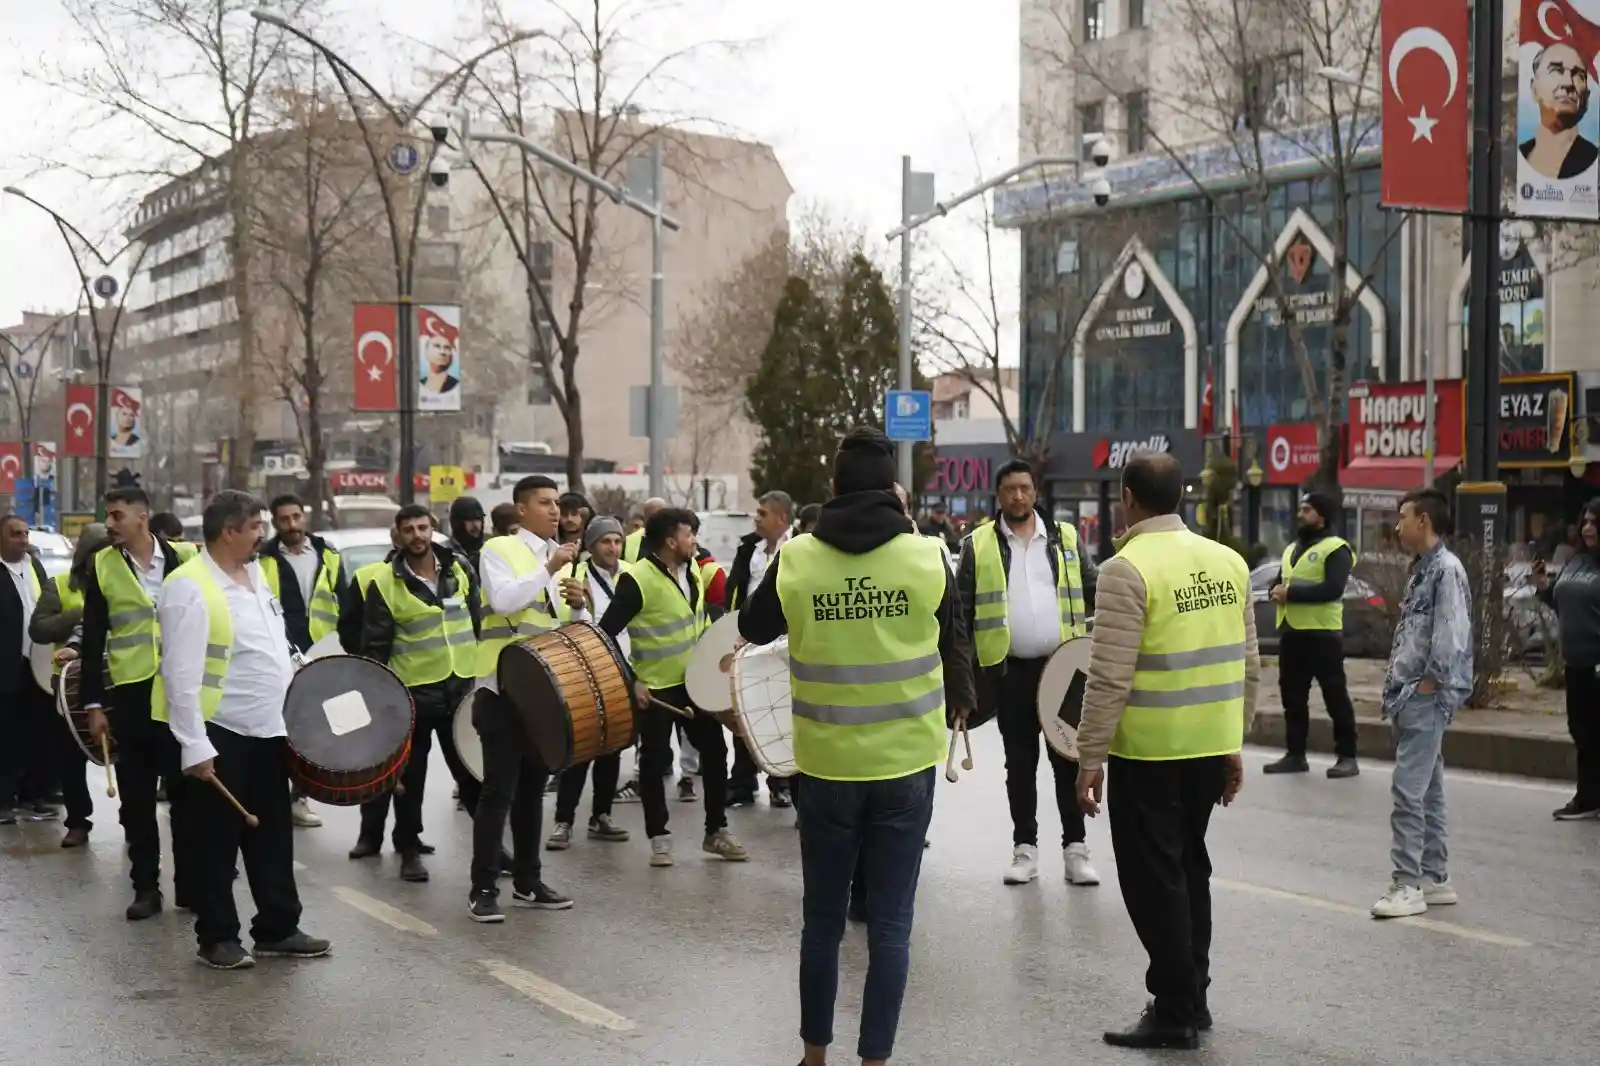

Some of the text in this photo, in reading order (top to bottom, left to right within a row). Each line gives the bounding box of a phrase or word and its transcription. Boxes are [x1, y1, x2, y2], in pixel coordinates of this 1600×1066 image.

[1360, 394, 1438, 425] HARPU
[1500, 393, 1544, 418] EYAZ
[1499, 422, 1547, 450] ÖNER
[925, 455, 989, 491] FOON
[844, 576, 877, 592] T.C.
[1189, 571, 1213, 585] T.C.
[812, 589, 909, 608] KÜTAHYA
[1173, 580, 1236, 602] KÜTAHYA
[813, 603, 909, 621] BELEDİYESİ
[1176, 592, 1238, 614] BELEDİYESİ
